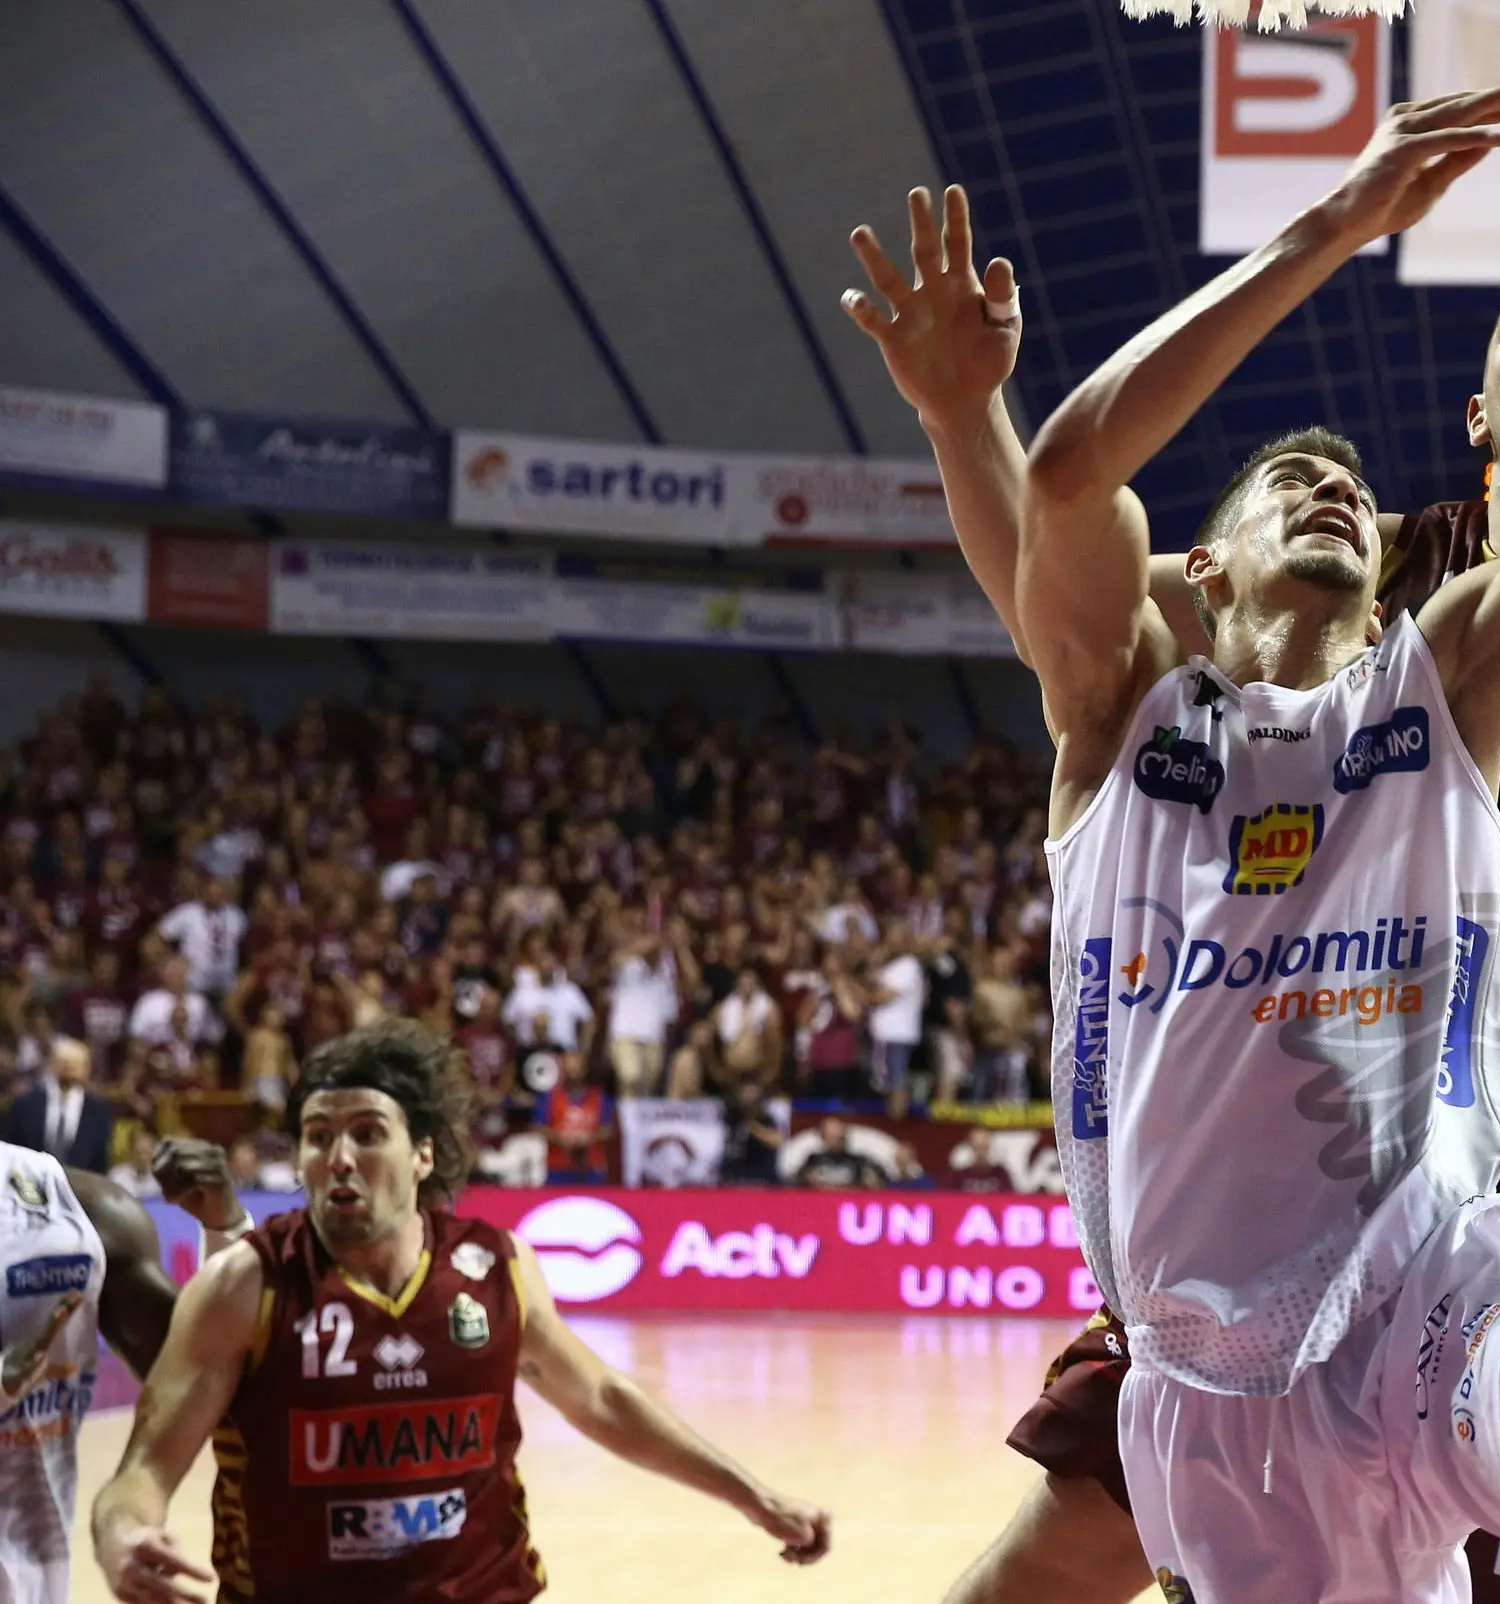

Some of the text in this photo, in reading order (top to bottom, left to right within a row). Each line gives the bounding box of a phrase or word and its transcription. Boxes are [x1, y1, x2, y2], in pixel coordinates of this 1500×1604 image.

[526, 457, 726, 510] sartori
[1247, 727, 1312, 746] PALDING
[1243, 826, 1309, 862] MD
[1178, 916, 1428, 991] Dolomiti
[1251, 979, 1423, 1025] energia
[837, 1203, 933, 1246] UN
[660, 1220, 821, 1280] Actv
[898, 1265, 1045, 1310] UNO
[294, 1301, 357, 1379] 12
[305, 1410, 482, 1473] UMANA
